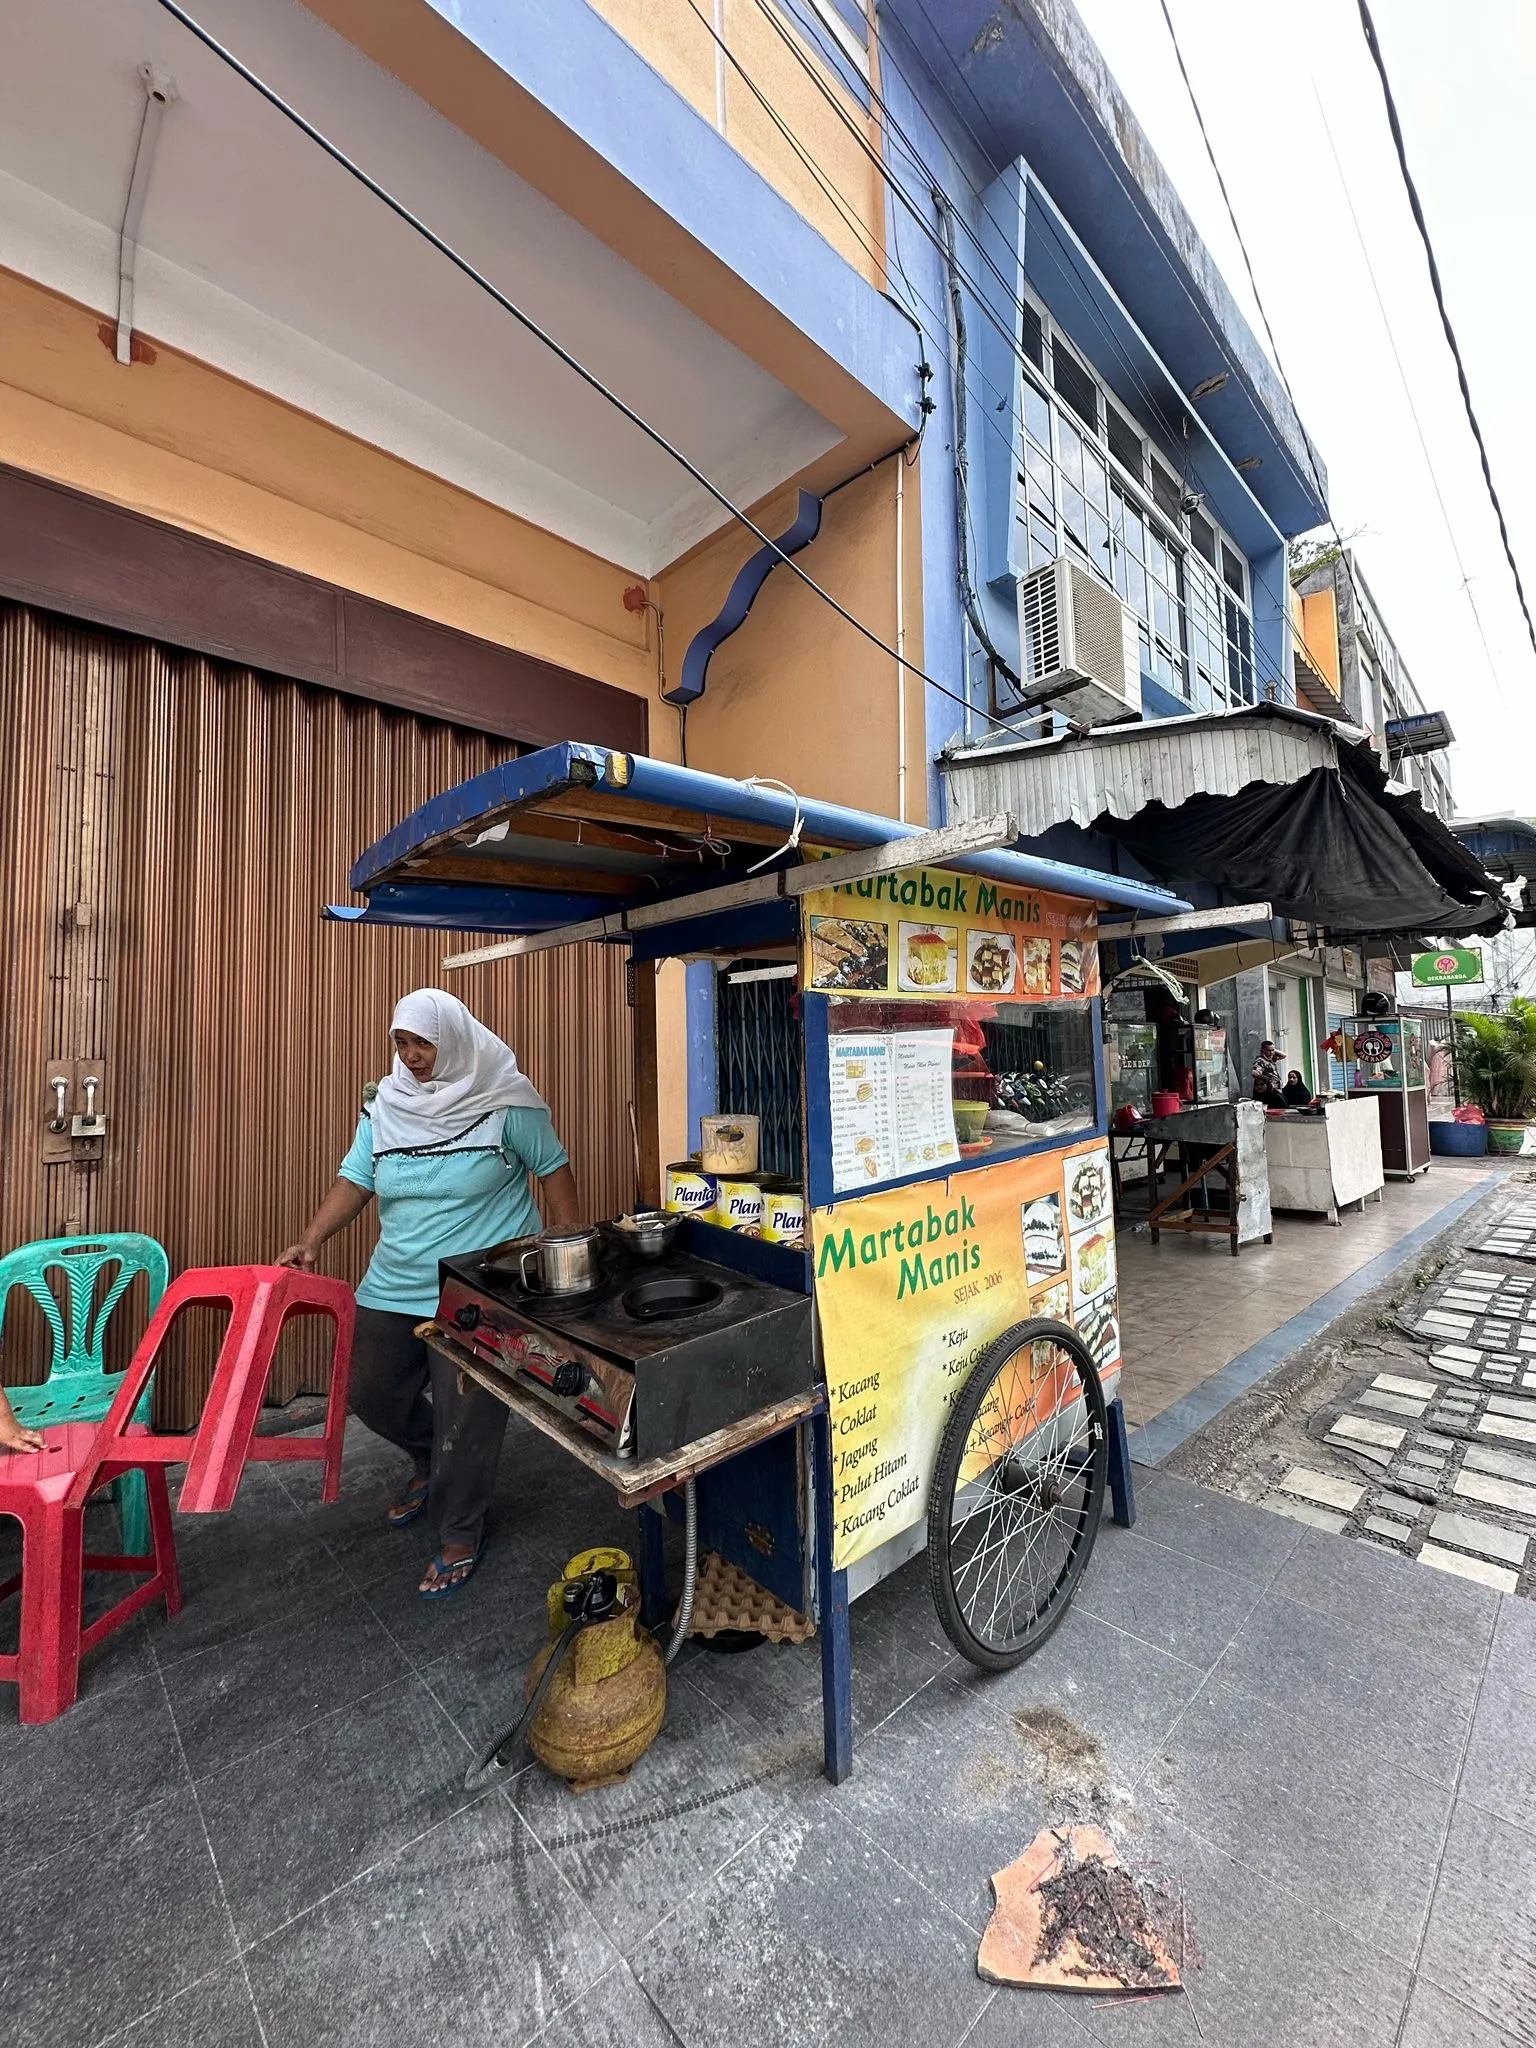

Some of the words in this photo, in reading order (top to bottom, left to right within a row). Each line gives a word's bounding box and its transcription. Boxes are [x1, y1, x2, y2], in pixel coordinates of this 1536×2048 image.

[975, 882, 1041, 924] Manis
[675, 1187, 715, 1201] Planta
[730, 1199, 760, 1214] Plan
[773, 1213, 804, 1229] Plan
[817, 1195, 977, 1278] Martabak
[897, 1241, 981, 1300] Manis
[954, 1280, 980, 1304] SEJAK
[984, 1270, 1003, 1290] 2006
[948, 1328, 968, 1348] Keju
[948, 1356, 968, 1377] Keju
[838, 1372, 880, 1403] Kacang
[840, 1404, 877, 1435] Coklat
[975, 1397, 1000, 1418] acang
[839, 1437, 878, 1477] Jagung
[840, 1472, 872, 1504] Pulut
[873, 1453, 907, 1484] Hitam
[841, 1501, 886, 1537] Kacang
[888, 1474, 919, 1508] Coklat
